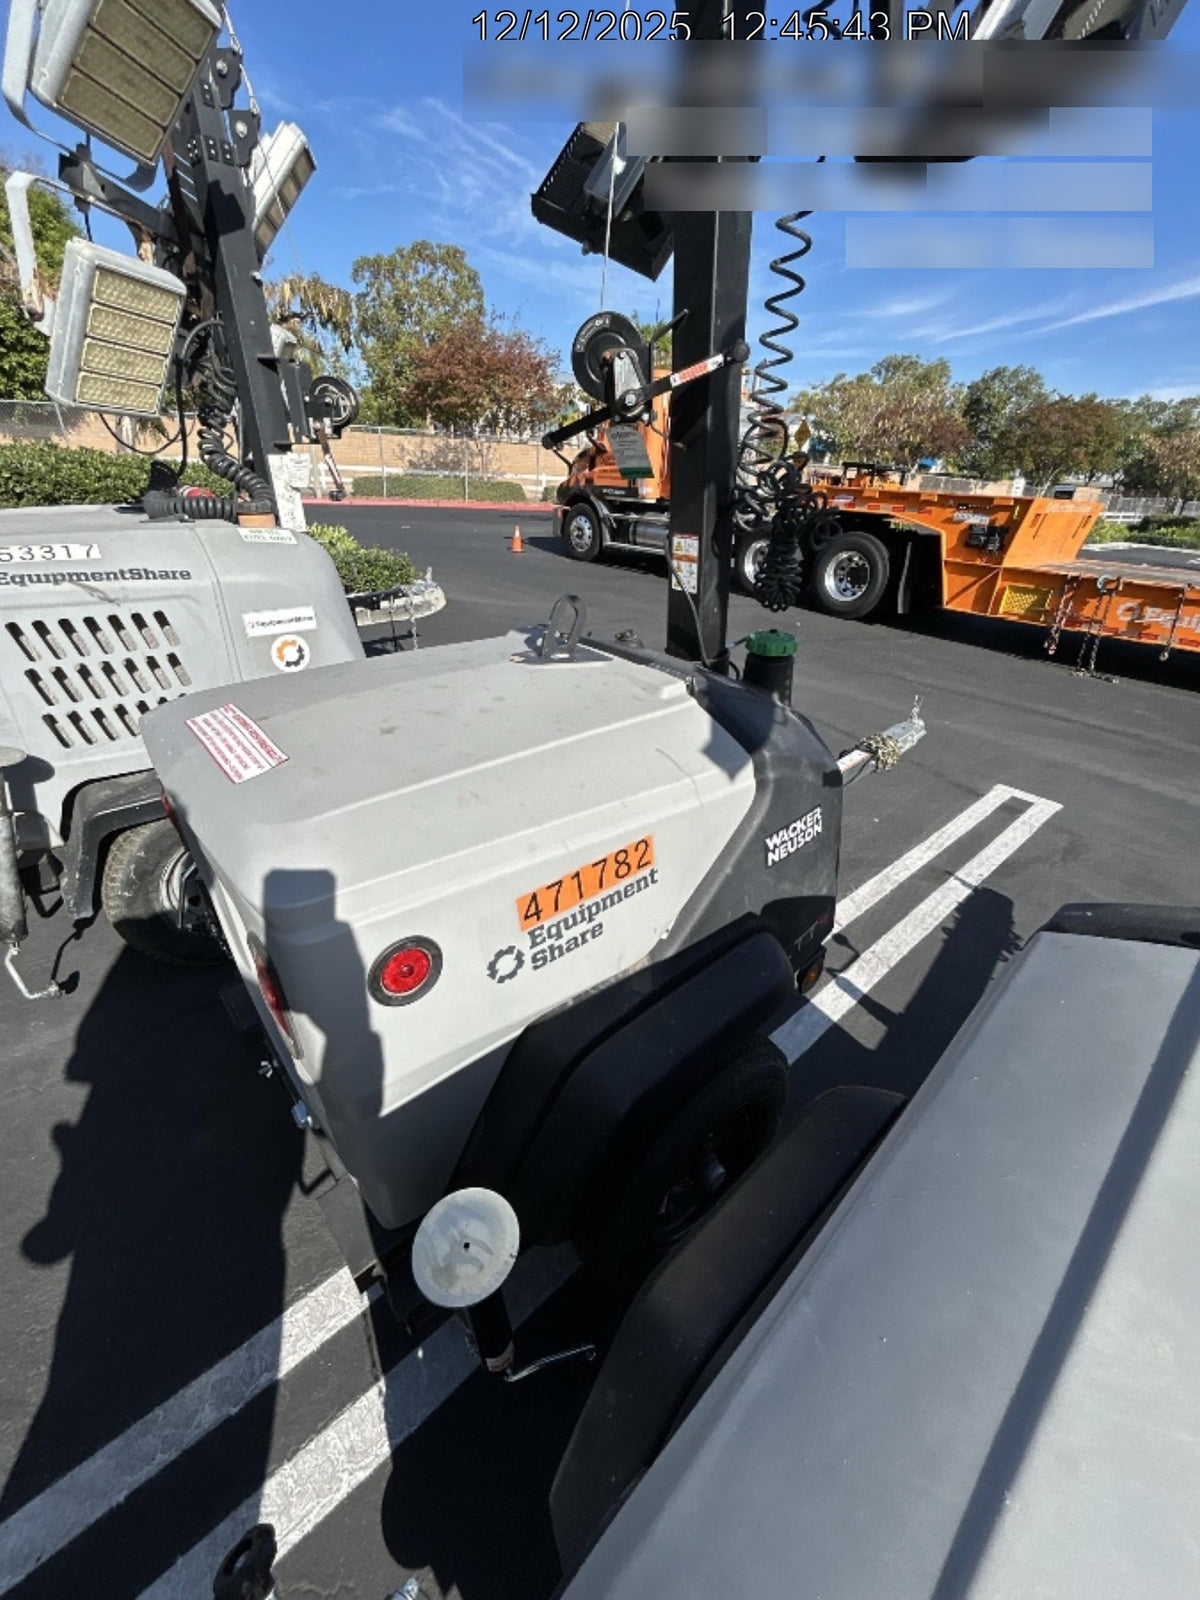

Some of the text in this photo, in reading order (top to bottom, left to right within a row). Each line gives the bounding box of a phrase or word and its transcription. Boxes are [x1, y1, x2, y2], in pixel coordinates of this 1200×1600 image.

[765, 807, 821, 850] WACKER
[767, 819, 823, 867] NEUSON
[523, 838, 651, 922] 471782
[527, 867, 658, 950] Equipment
[531, 922, 604, 970] Share
